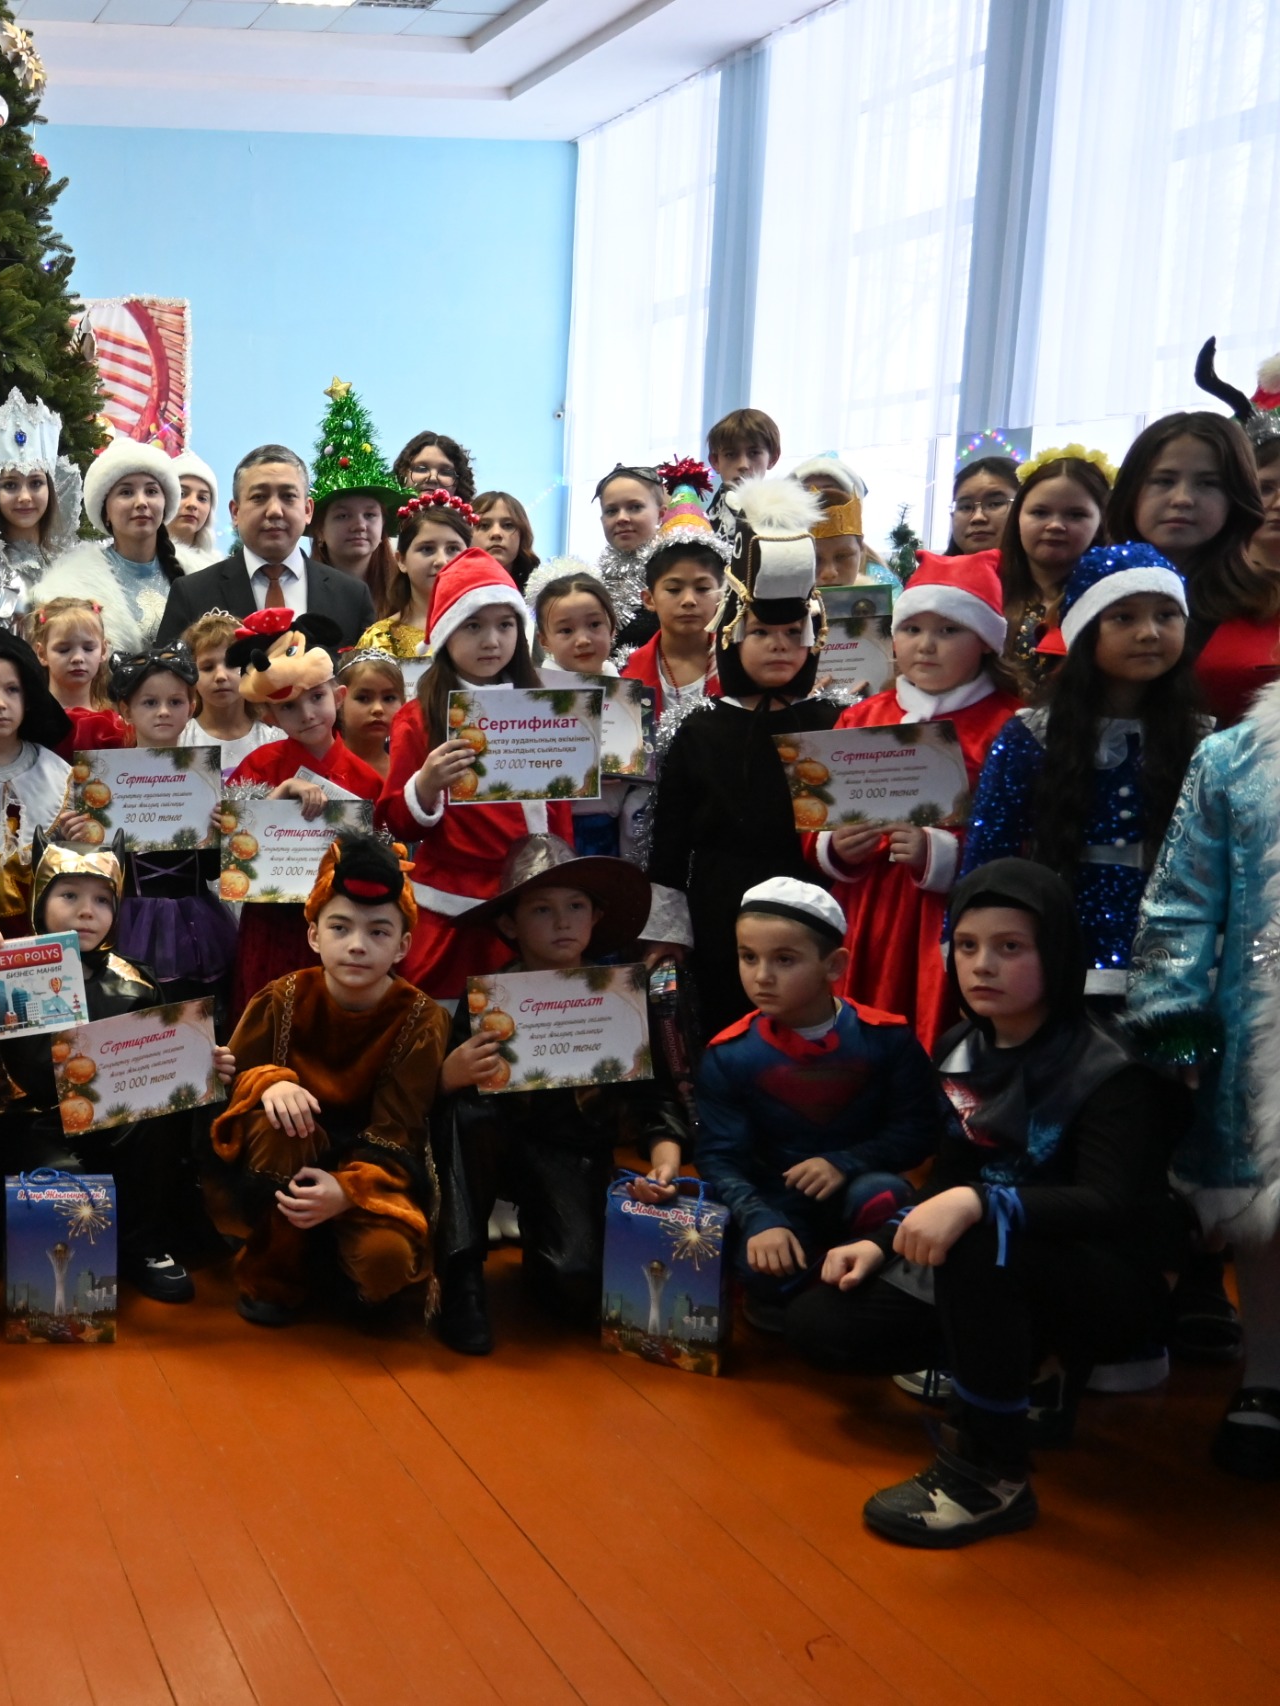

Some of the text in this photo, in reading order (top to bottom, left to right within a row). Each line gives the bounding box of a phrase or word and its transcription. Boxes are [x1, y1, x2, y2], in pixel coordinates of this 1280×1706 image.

[478, 716, 578, 733] Сертификат
[493, 758, 562, 770] 30 000 теңге
[831, 748, 916, 765] Сертификат
[116, 772, 186, 788] Сертификат
[849, 789, 863, 800] 30
[866, 788, 887, 798] 000
[124, 813, 136, 823] 30
[139, 812, 156, 823] 000
[264, 825, 336, 841] Сертификат
[271, 866, 283, 876] 30
[286, 866, 303, 876] 000
[6, 965, 62, 979] БИЗНЕС МАНИЯ
[519, 996, 603, 1016] Сертификат
[100, 1027, 176, 1054] Сертификат
[532, 1044, 546, 1056] 30
[550, 1042, 570, 1055] 000
[113, 1080, 126, 1094] 30
[128, 1075, 148, 1091] 000
[622, 1200, 631, 1212] С
[632, 1202, 670, 1219] Новым
